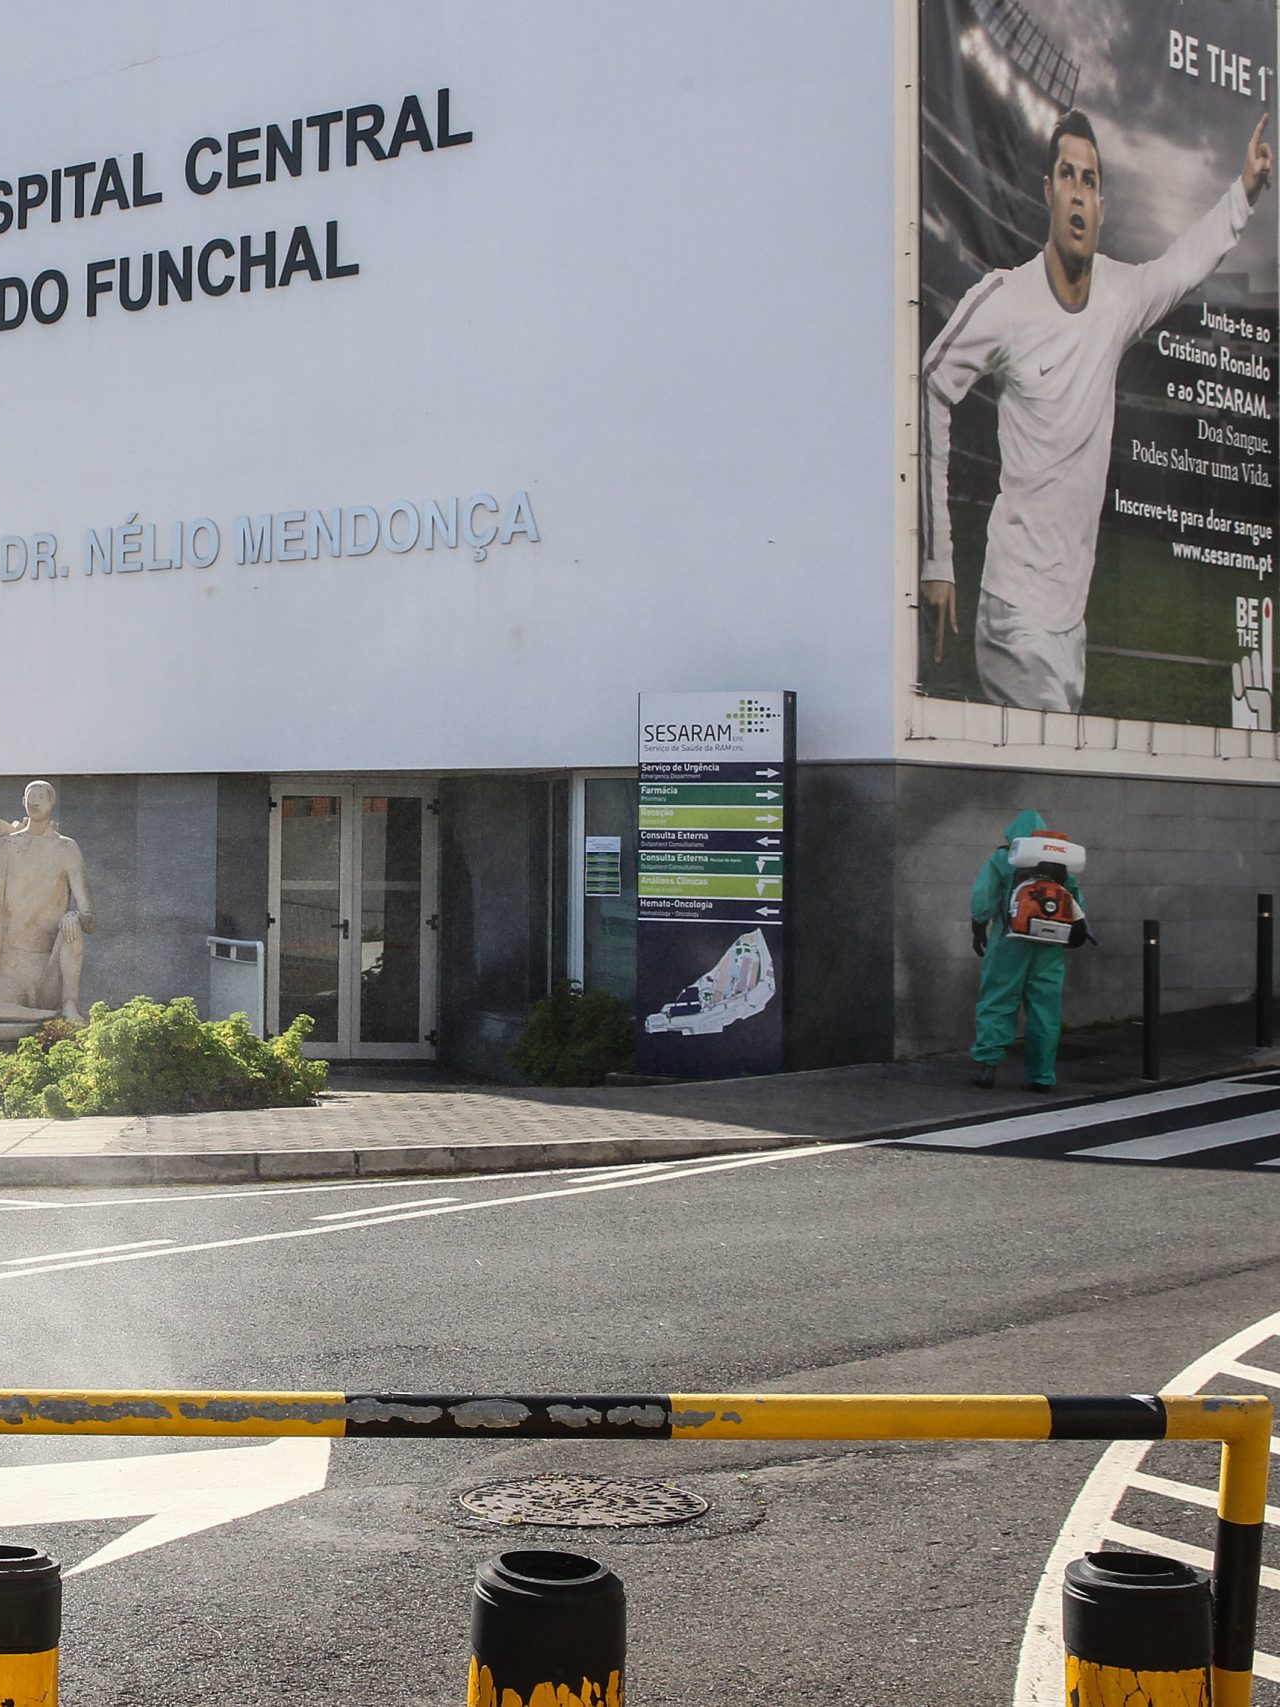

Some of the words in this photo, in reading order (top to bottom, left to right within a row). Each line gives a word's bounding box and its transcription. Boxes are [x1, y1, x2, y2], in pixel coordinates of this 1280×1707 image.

[1169, 29, 1199, 77] BE
[1206, 43, 1251, 96] THE
[185, 88, 473, 195] CENTRAL
[86, 220, 359, 317] FUNCHAL
[1200, 302, 1253, 338] Junta-te
[1256, 326, 1271, 343] ao
[1158, 330, 1217, 367] Cristiano
[1220, 346, 1271, 381] Ronaldo
[1167, 382, 1175, 397] e
[1178, 384, 1193, 401] ao
[1196, 379, 1271, 420] SESARAM.
[1197, 418, 1223, 444] Doa
[1226, 425, 1272, 456] Sangue.
[1131, 439, 1168, 467] Podes
[1170, 448, 1209, 476] Salvar
[1211, 462, 1239, 482] uma
[1241, 463, 1272, 488] Vida.
[1115, 488, 1179, 523] Inscreve-te
[1180, 511, 1204, 533] para
[1206, 508, 1232, 532] doar
[1234, 520, 1273, 546] sangue
[0, 532, 69, 583] DR.
[83, 512, 220, 576] NÉLIO
[235, 490, 540, 563] MENDONÇA
[1172, 542, 1273, 581] www.sesaram.pt
[1236, 596, 1259, 629] BE
[1236, 628, 1259, 648] THE
[644, 724, 732, 742] SESARAM
[644, 745, 670, 753] Serviço
[681, 744, 703, 752] Saúde
[641, 763, 670, 773] Serviço
[672, 763, 682, 771] de
[684, 763, 720, 773] Urgência
[641, 786, 678, 794] Farmácia
[640, 831, 676, 839] Consulta
[677, 832, 709, 840] Externa
[640, 853, 676, 862] Consulta
[677, 853, 709, 862] Externa
[640, 899, 713, 910] Hemato-Oncologia
